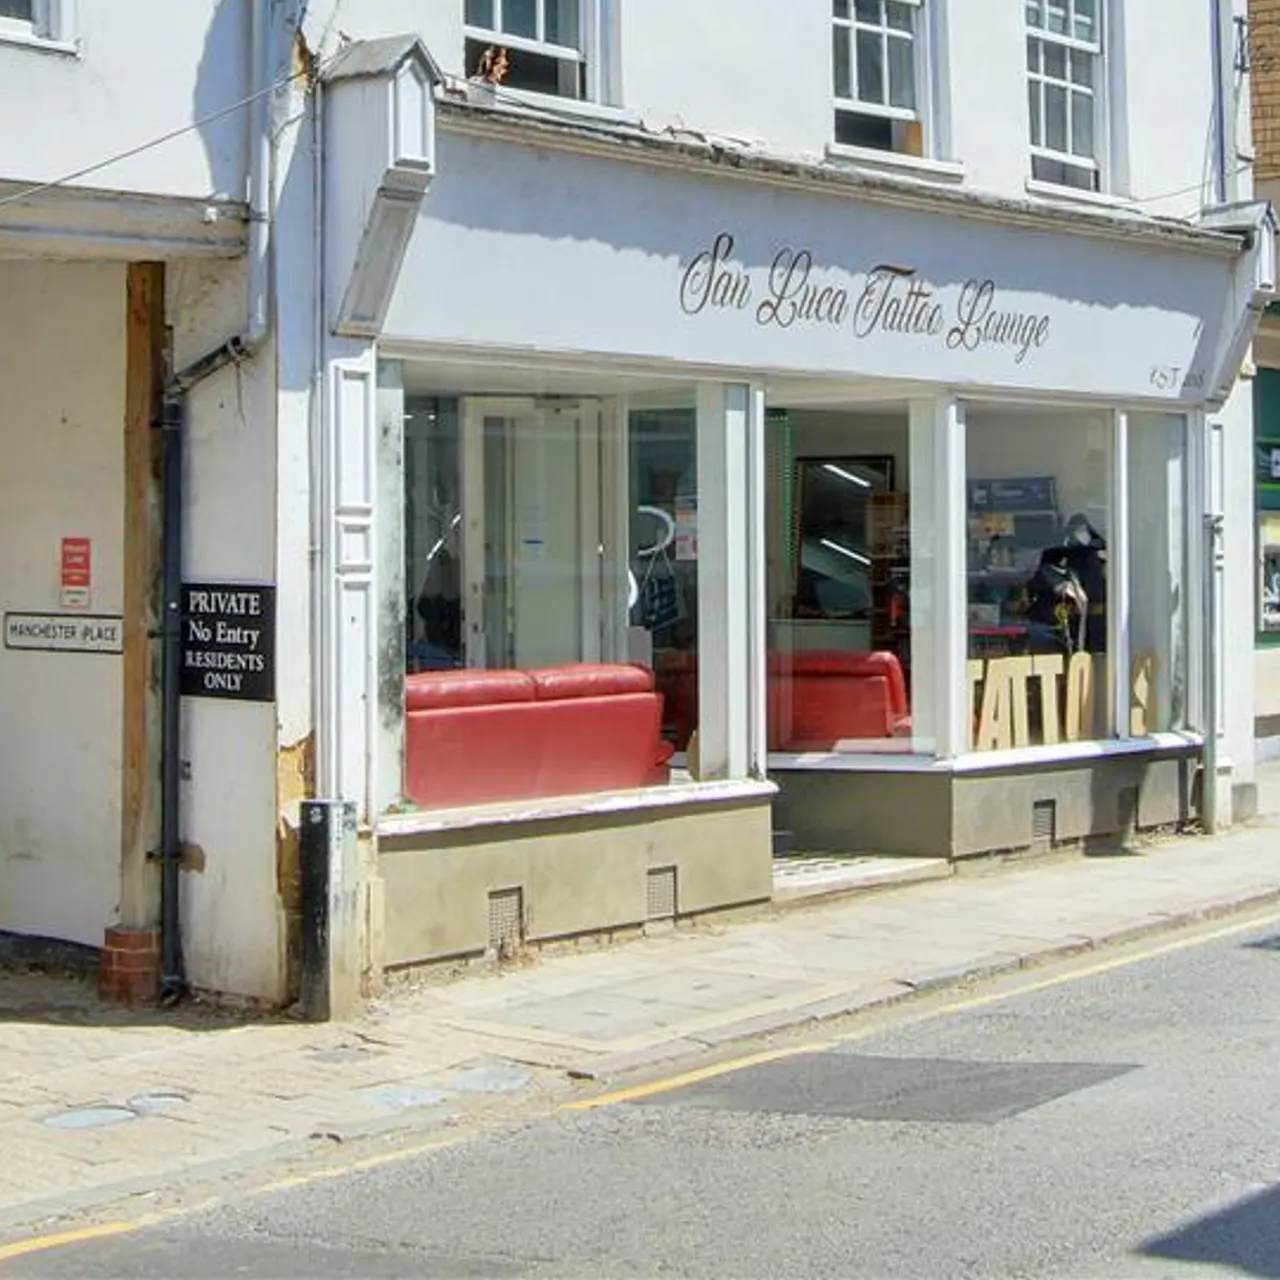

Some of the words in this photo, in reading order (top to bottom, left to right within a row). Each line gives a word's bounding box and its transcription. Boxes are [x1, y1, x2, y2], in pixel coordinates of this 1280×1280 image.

[680, 232, 752, 314] San
[756, 247, 848, 328] Luca
[853, 264, 943, 338] Tattoo
[946, 278, 1050, 364] Lounge
[189, 591, 261, 615] PRIVATE
[9, 622, 78, 641] MANCHESTER
[82, 624, 117, 642] PLACE
[189, 619, 212, 642] No
[216, 621, 260, 651] Entry
[184, 650, 265, 672] RESIDENTS
[203, 672, 244, 692] ONLY
